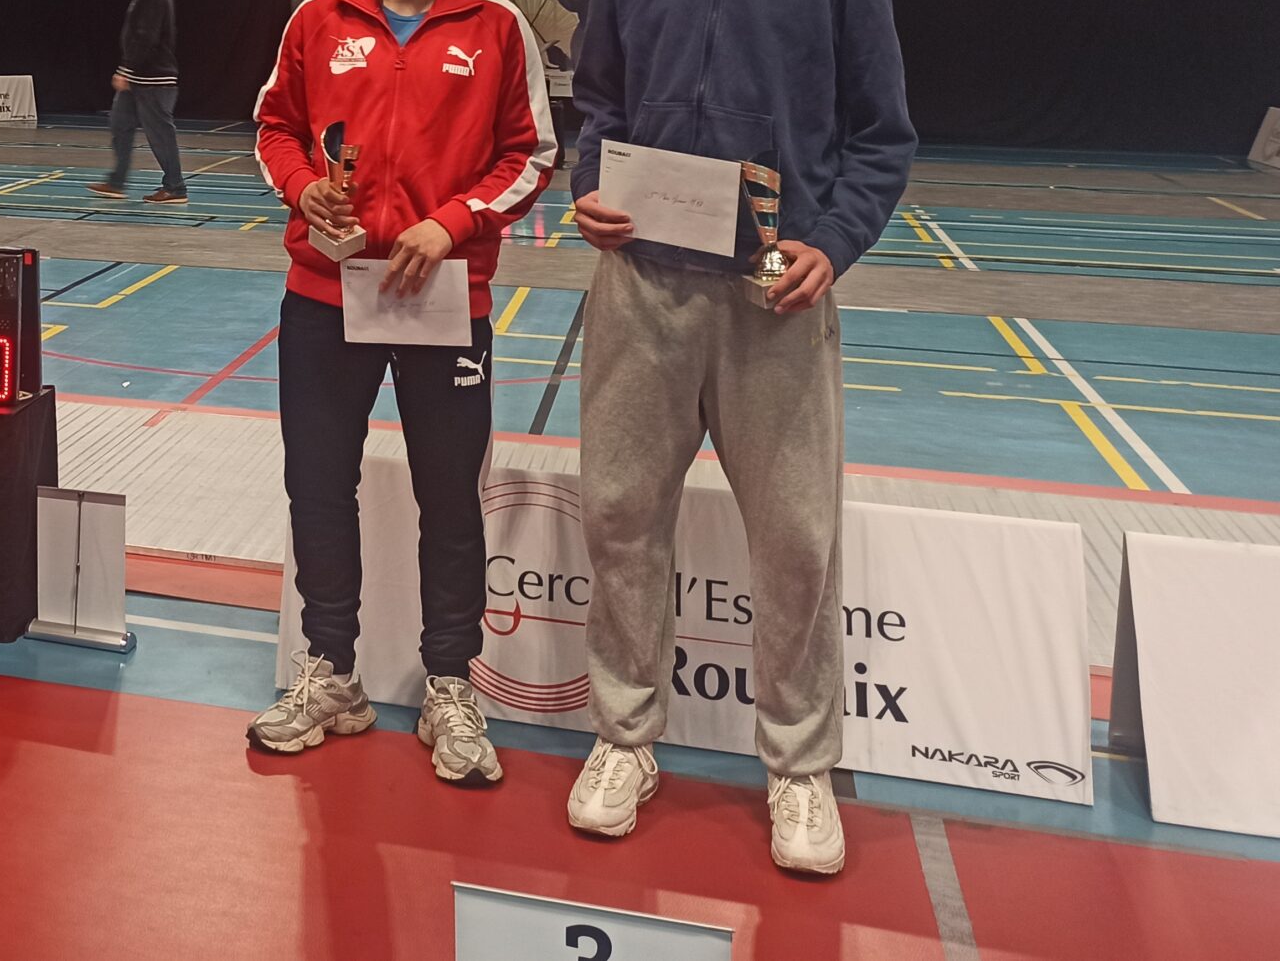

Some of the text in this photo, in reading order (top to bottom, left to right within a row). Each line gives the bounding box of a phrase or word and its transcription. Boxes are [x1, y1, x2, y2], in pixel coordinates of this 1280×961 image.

[454, 374, 481, 387] PUMA
[486, 554, 590, 606] Cerc
[911, 744, 1020, 773] NAKARA
[991, 770, 1021, 781] SPORT
